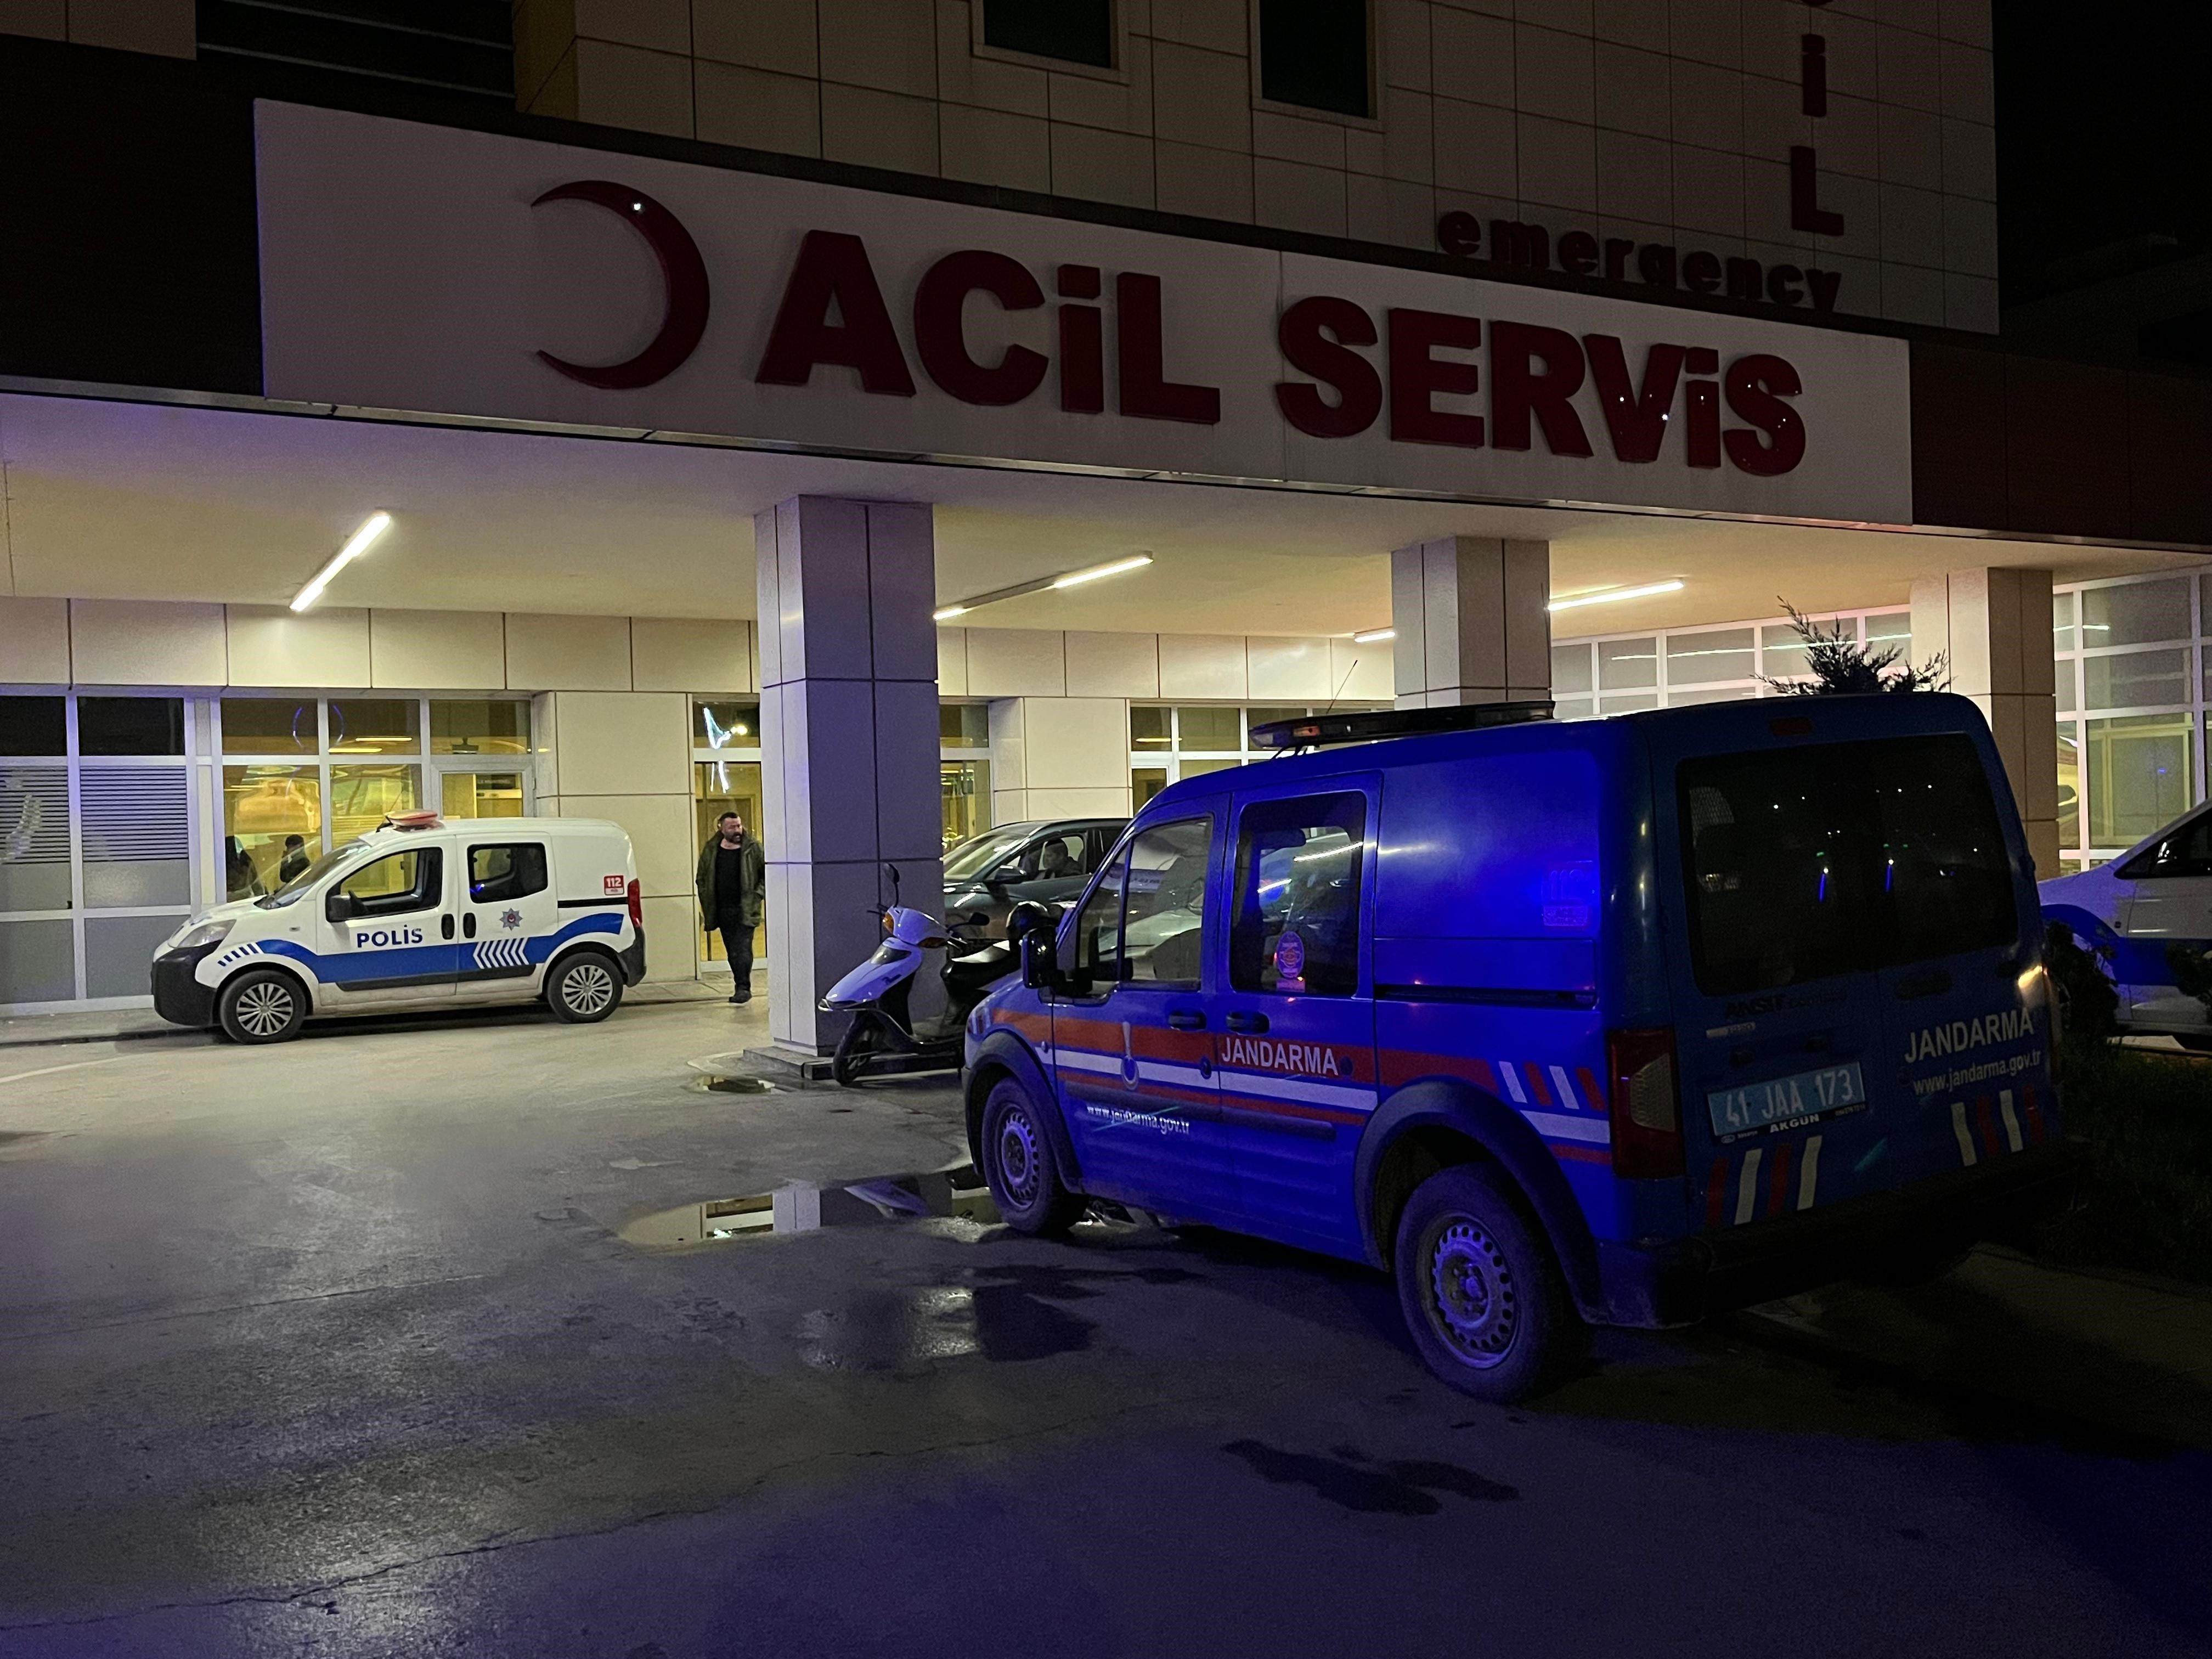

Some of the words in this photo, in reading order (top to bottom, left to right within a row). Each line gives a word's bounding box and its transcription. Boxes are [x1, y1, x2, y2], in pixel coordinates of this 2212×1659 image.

[1790, 0, 1843, 236] iL
[606, 877, 622, 887] 112
[357, 924, 423, 947] POLİS
[1221, 1037, 1339, 1076] JANDARMA
[1904, 1007, 2035, 1063] JANDARMA
[1914, 1048, 2041, 1096] www.jandarma.gov.tr
[1726, 1090, 1750, 1126] 41
[1761, 1080, 1804, 1120] JAA
[1815, 1070, 1853, 1106] 173
[1086, 1105, 1189, 1136] www.jandarma.gov.tr
